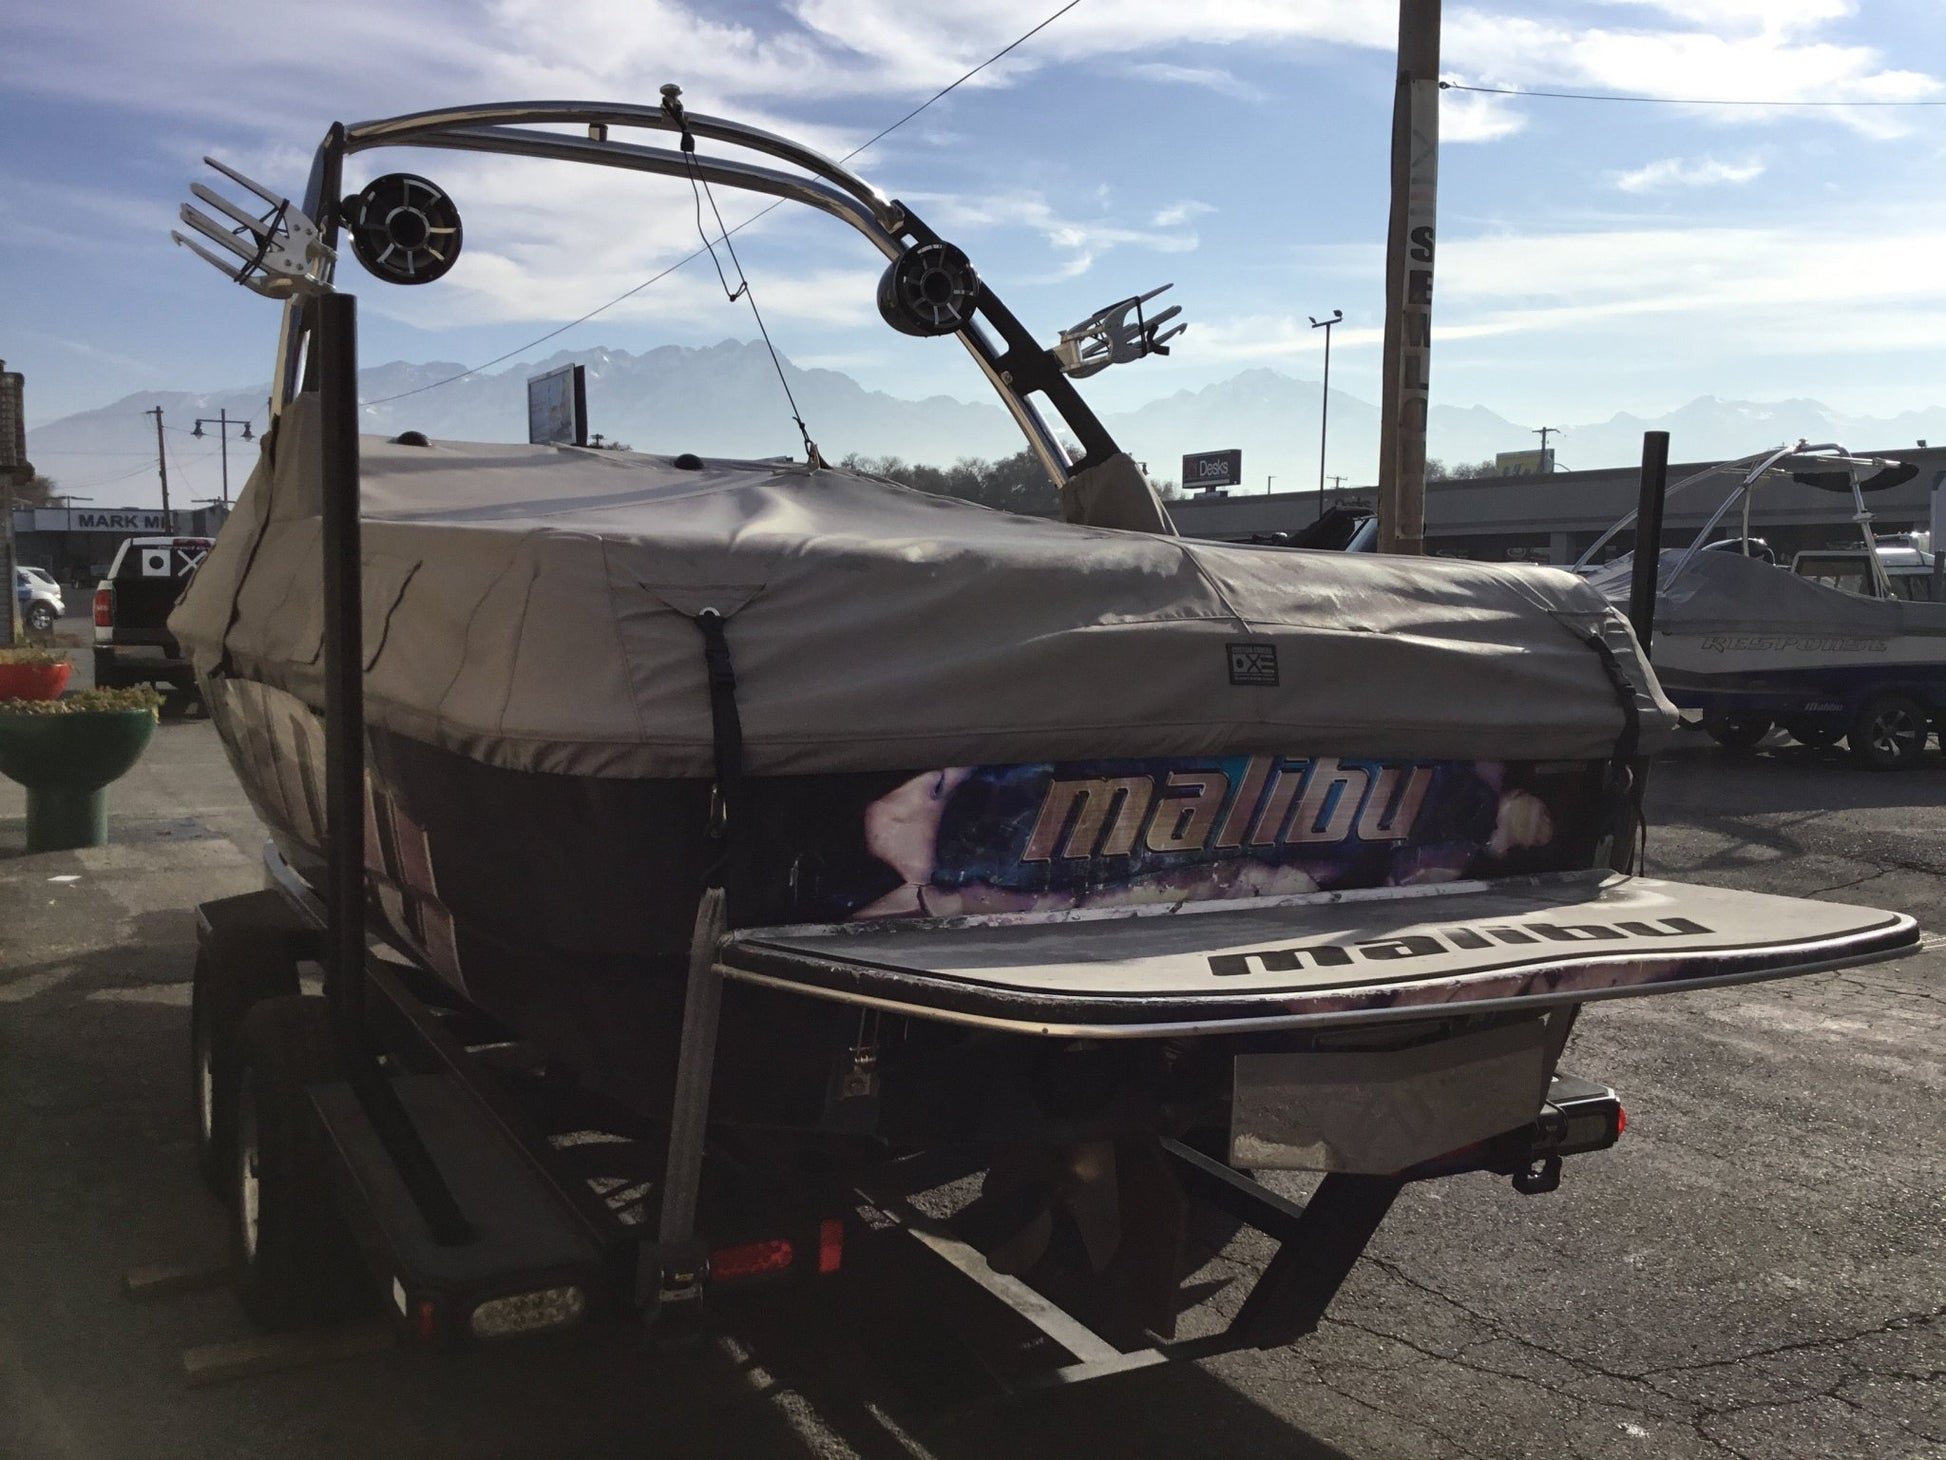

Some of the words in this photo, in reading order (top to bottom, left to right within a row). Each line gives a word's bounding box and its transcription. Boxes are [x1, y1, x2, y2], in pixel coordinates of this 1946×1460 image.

[1199, 458, 1229, 477] Desks
[78, 513, 138, 529] MARK
[1701, 637, 1888, 654] RESPONSE
[1019, 756, 1436, 863] malibu
[1207, 916, 1716, 977] malibu
